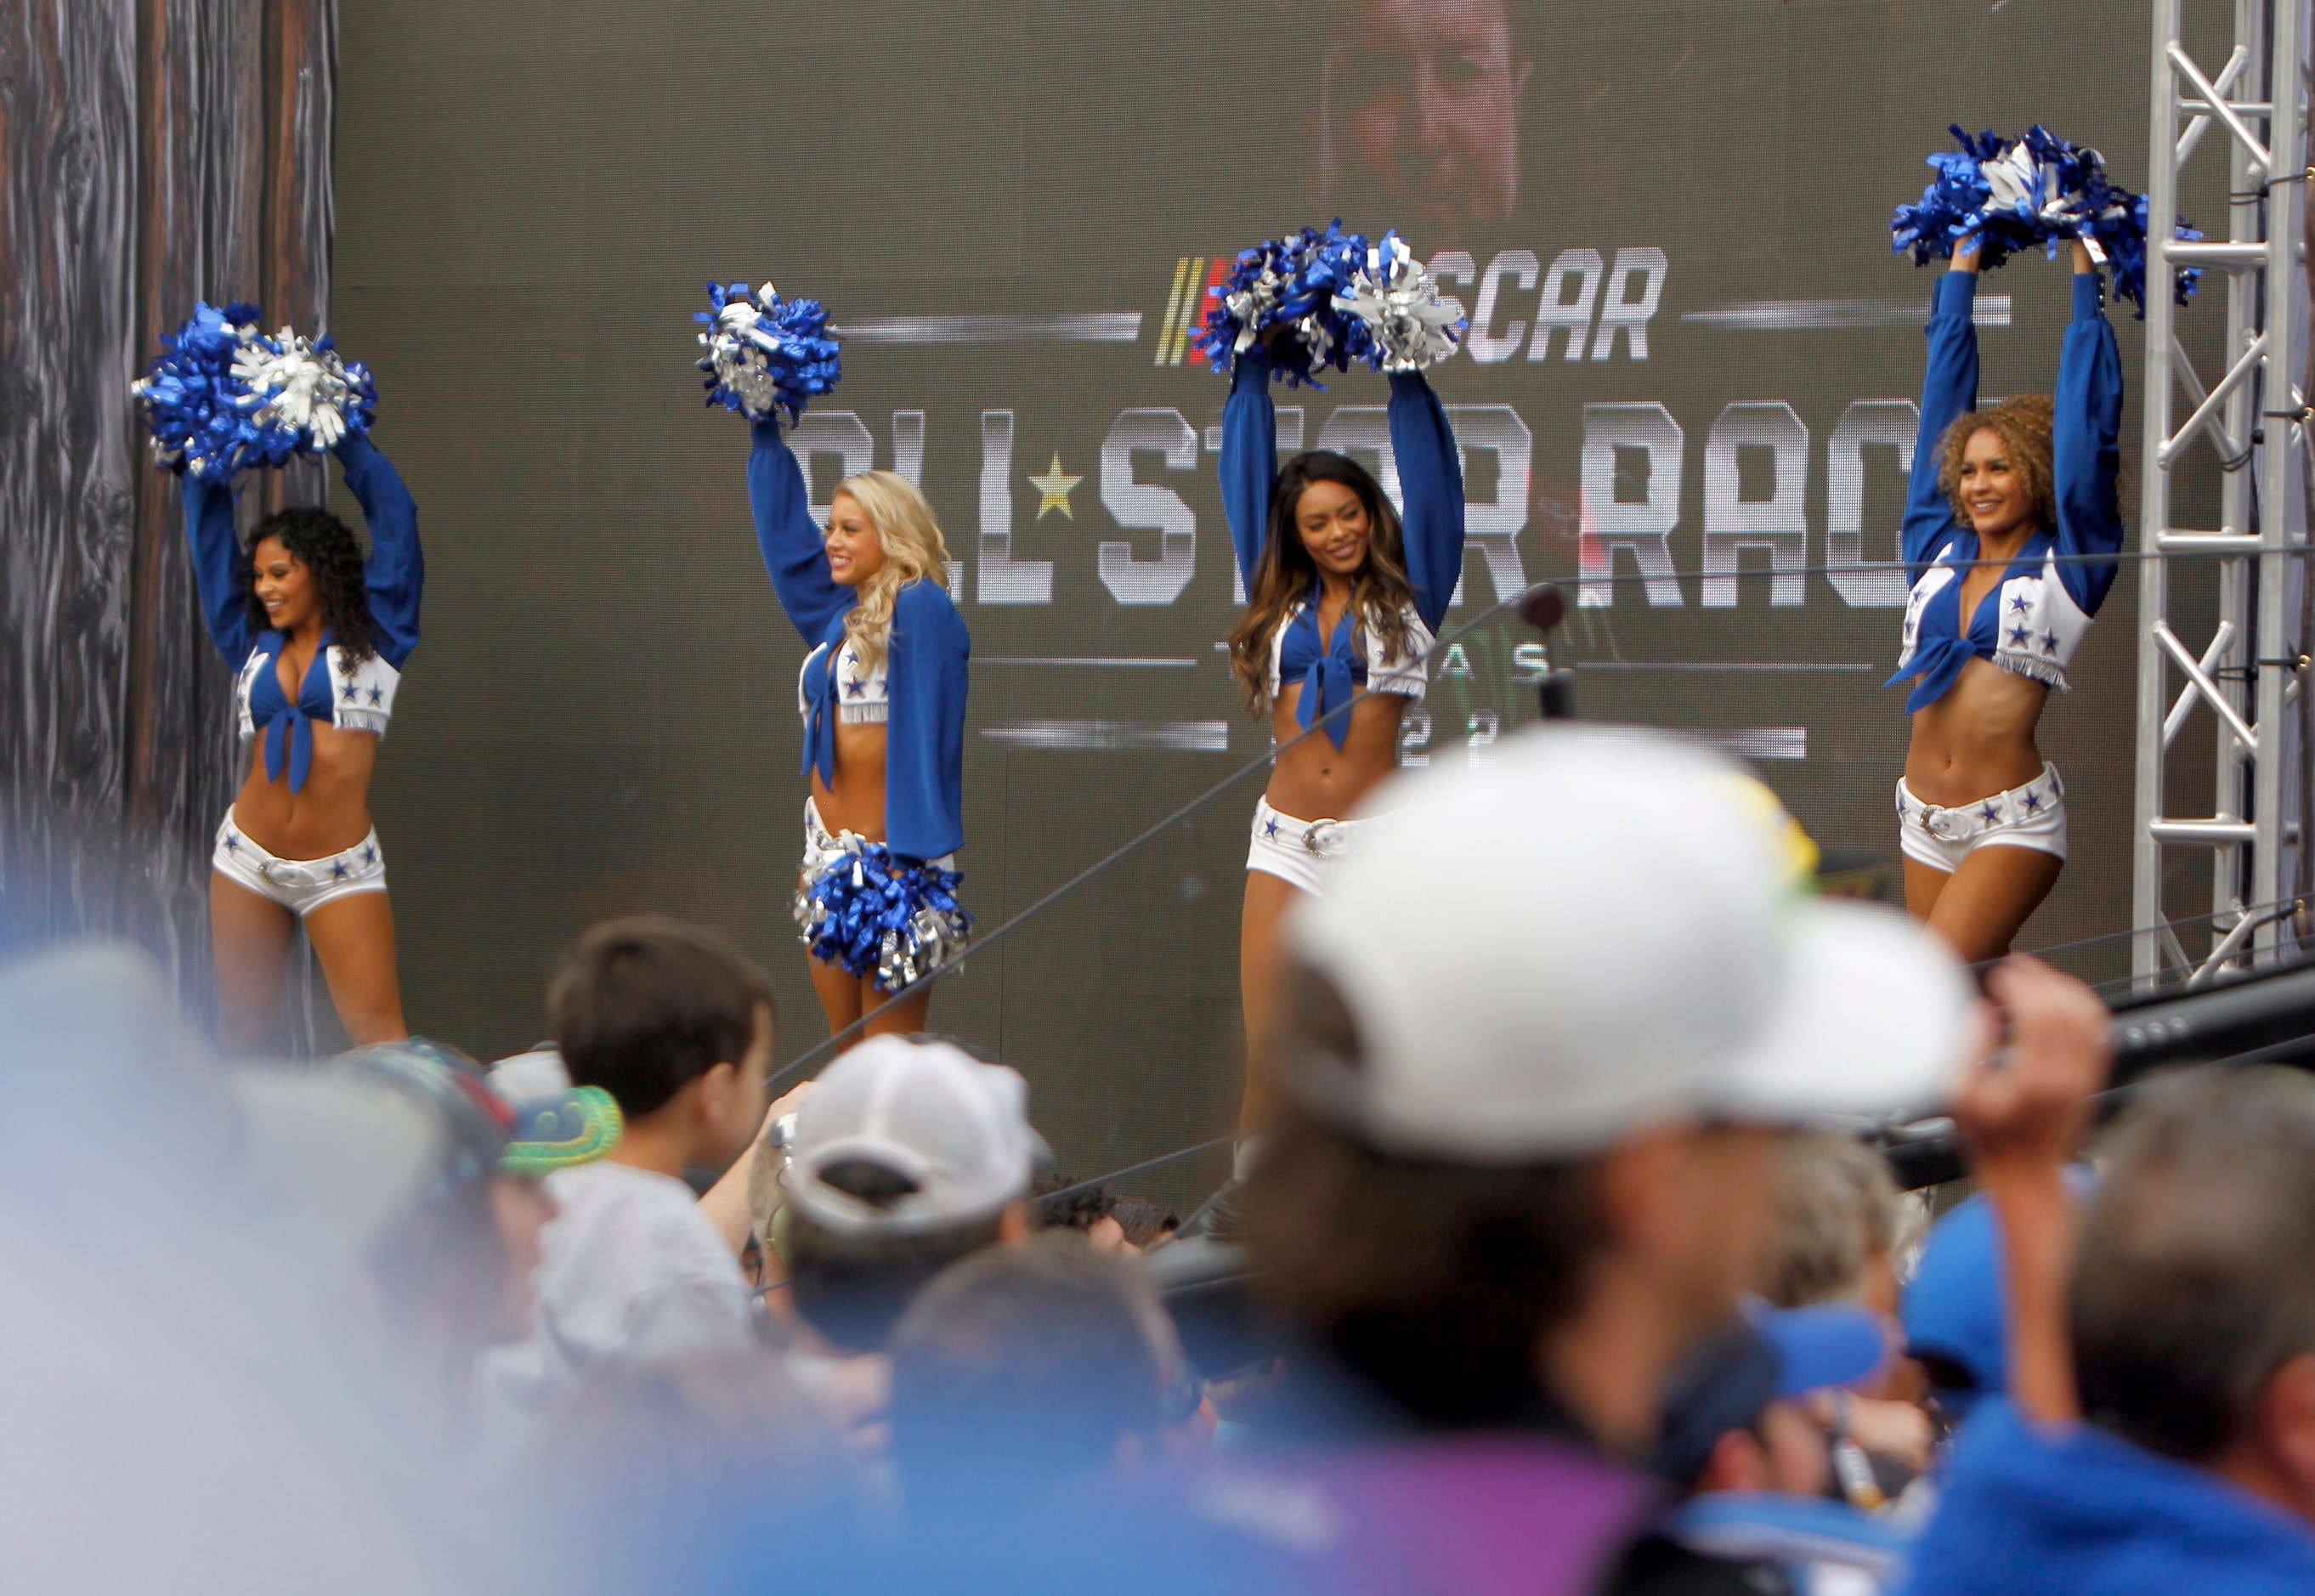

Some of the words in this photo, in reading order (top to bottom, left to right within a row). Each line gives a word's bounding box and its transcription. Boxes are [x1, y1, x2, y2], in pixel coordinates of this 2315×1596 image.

[1350, 246, 1668, 364] SCAR
[1098, 403, 1532, 607] SR
[1578, 399, 2009, 608] RAC
